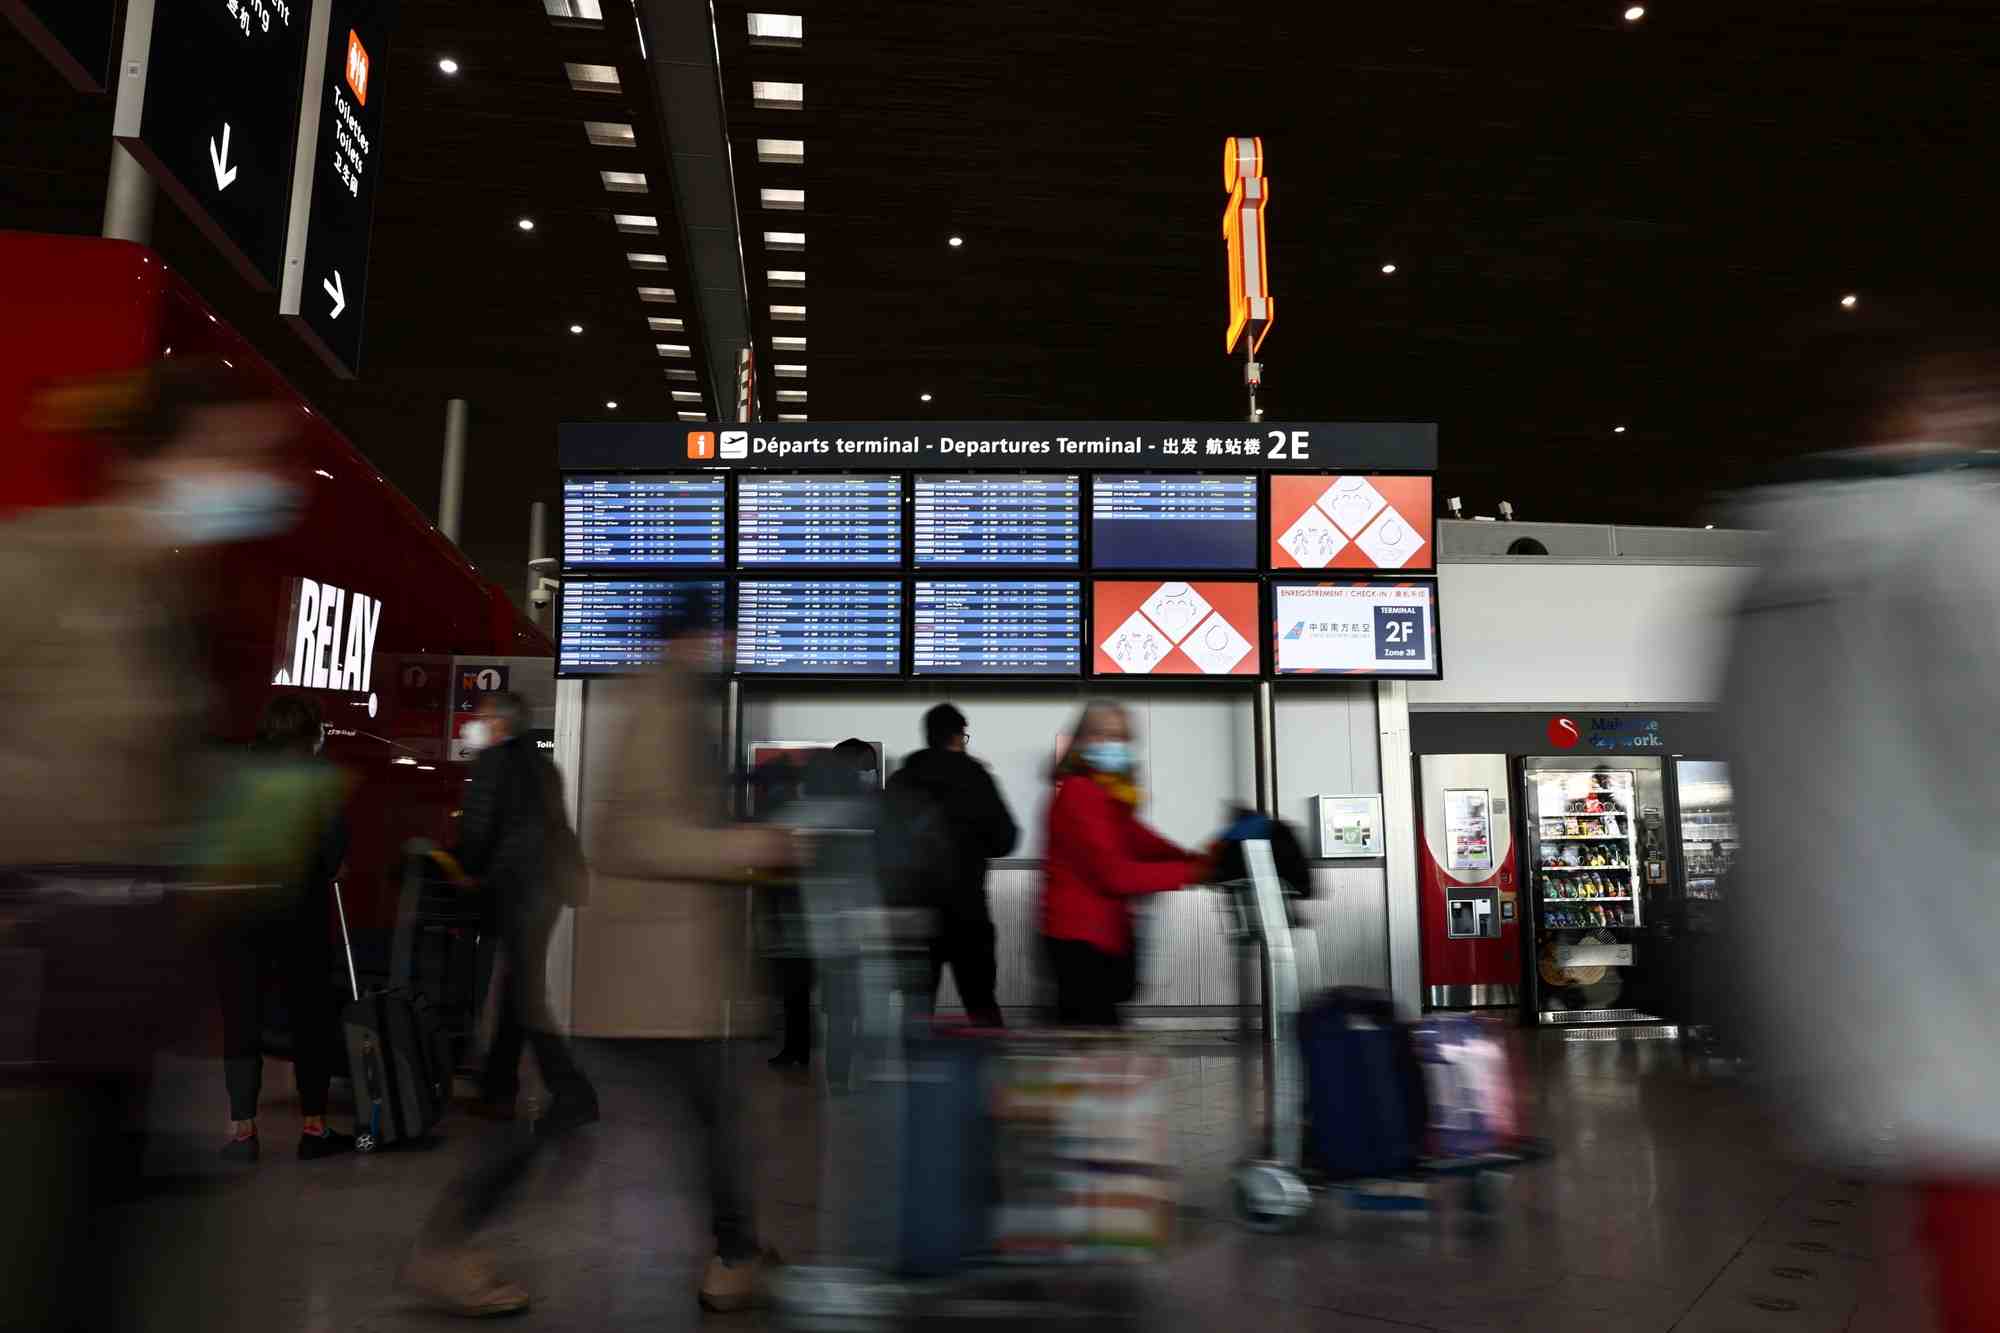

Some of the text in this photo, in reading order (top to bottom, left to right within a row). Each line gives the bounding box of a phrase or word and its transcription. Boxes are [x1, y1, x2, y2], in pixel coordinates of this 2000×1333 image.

[334, 85, 369, 155] Toilettes
[336, 119, 363, 174] Toilets
[753, 437, 830, 457] Départs
[836, 436, 919, 453] terminal
[940, 437, 1050, 457] Departures
[1056, 437, 1142, 453] Terminal
[1163, 438, 1198, 455] 出发
[1205, 438, 1262, 455] 航站楼
[1267, 431, 1310, 459] 2E
[291, 577, 382, 692] RELAY
[1384, 648, 1404, 657] Zone
[1385, 621, 1413, 643] 2F
